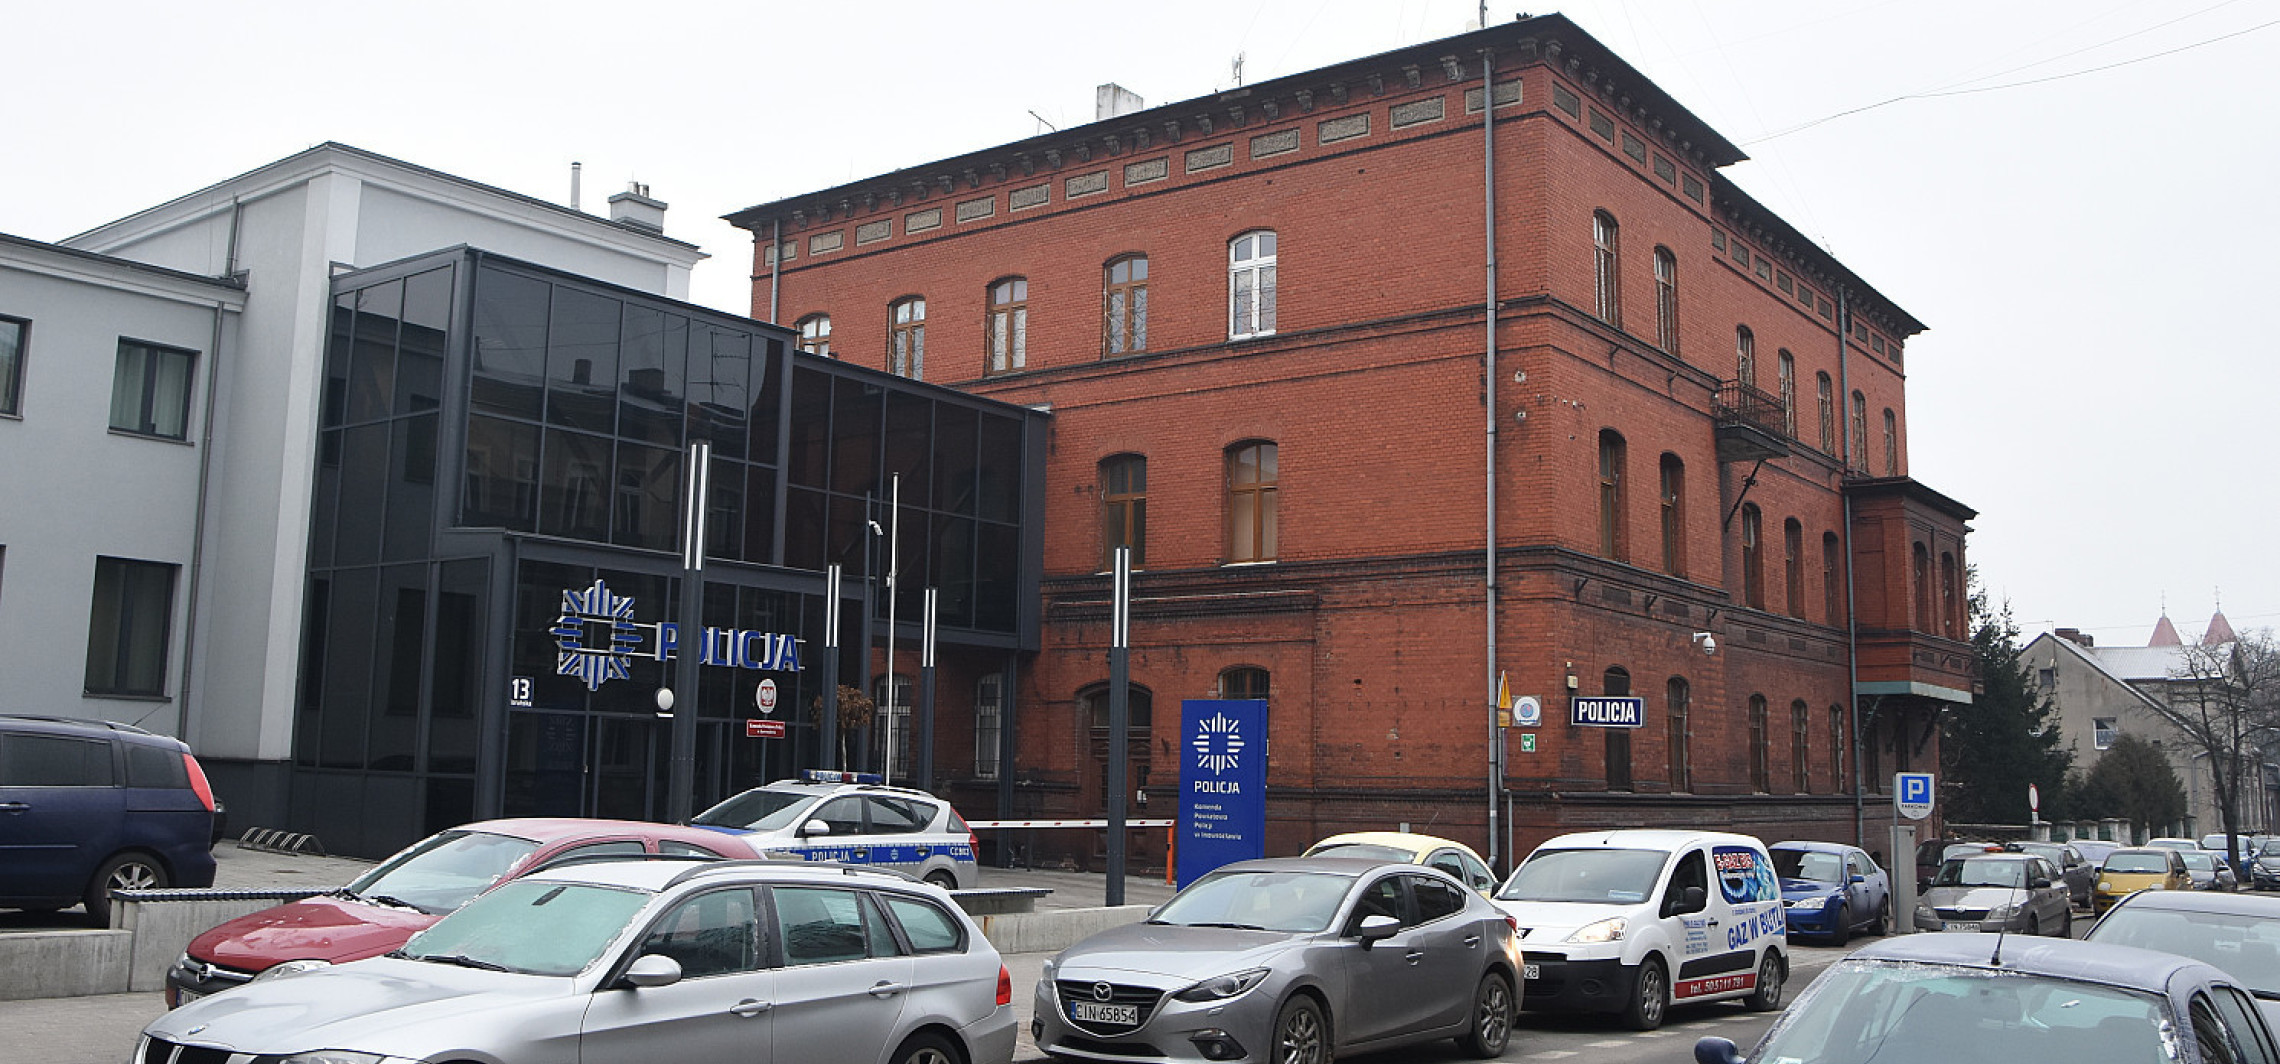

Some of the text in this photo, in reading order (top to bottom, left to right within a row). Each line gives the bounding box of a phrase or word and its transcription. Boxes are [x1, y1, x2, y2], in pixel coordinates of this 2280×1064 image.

[512, 678, 530, 699] 13
[1578, 701, 1636, 722] POLICJA
[1194, 780, 1240, 794] POLICJA
[1907, 779, 1924, 800] P
[1727, 921, 1749, 950] GAZ
[1748, 915, 1760, 940] W
[1100, 1007, 1136, 1024] 65854
